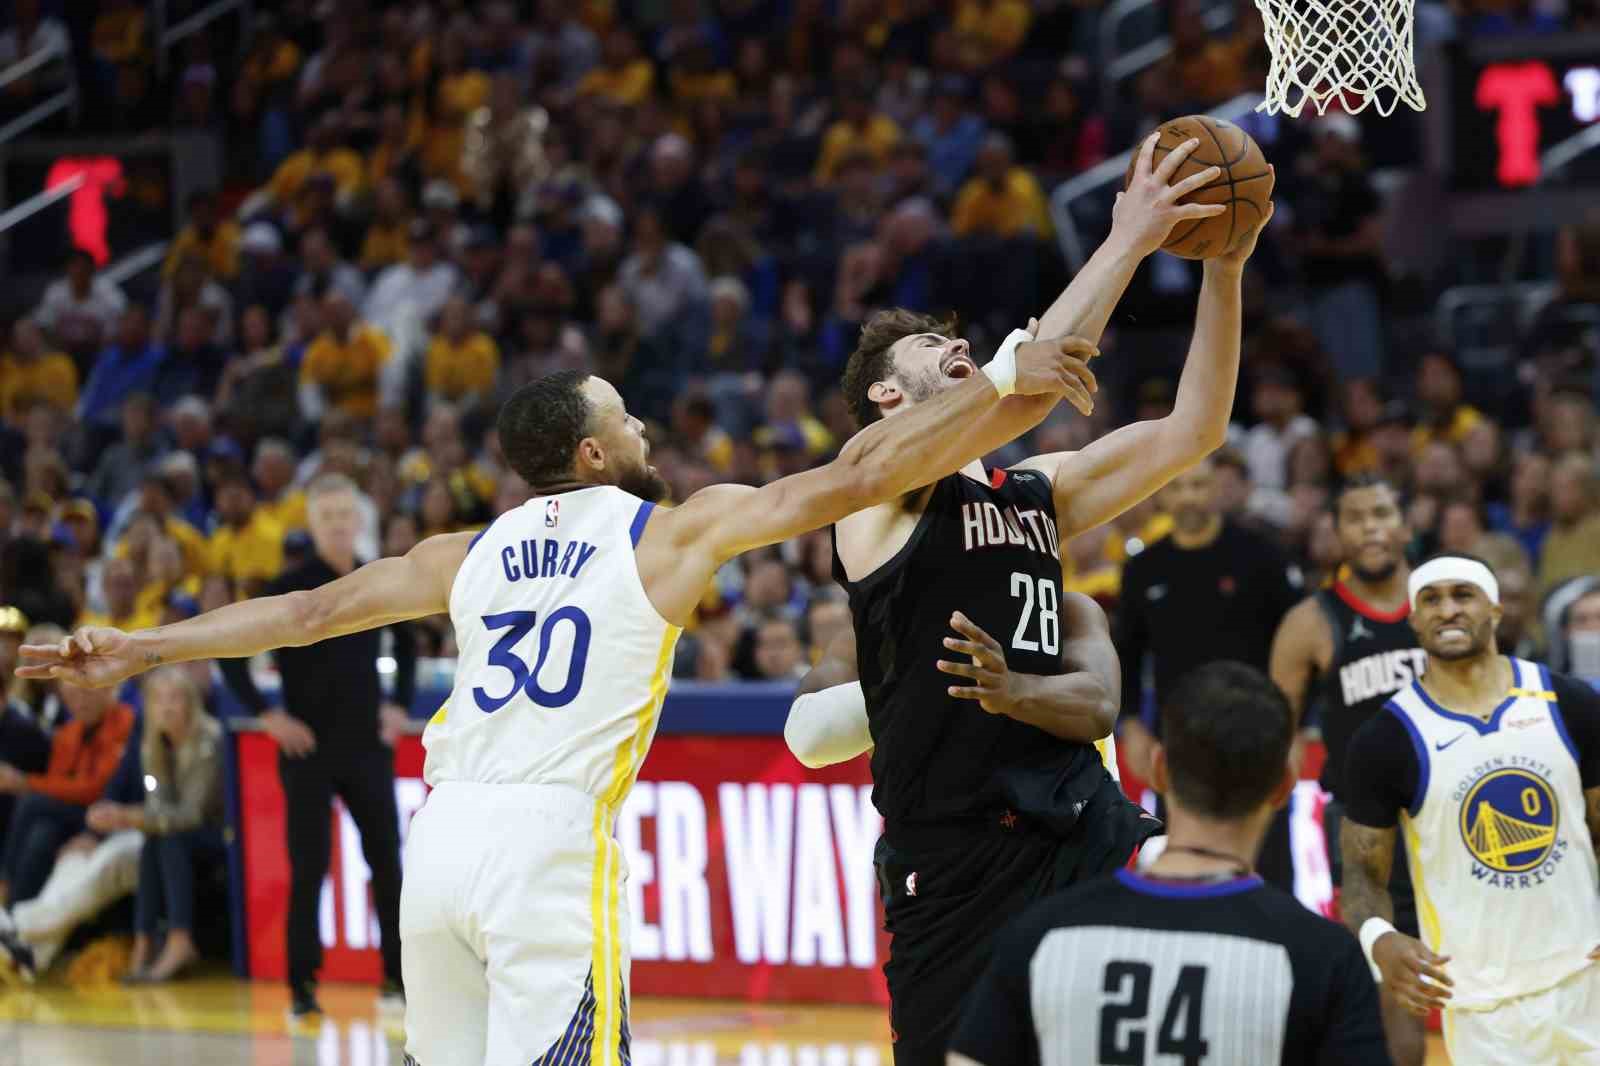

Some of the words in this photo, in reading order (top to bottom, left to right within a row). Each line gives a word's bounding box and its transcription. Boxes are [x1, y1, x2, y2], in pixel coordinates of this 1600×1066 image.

[501, 538, 597, 582] CURRY
[1010, 572, 1059, 656] 28
[472, 605, 592, 714] 30
[1340, 648, 1428, 706] HOUST
[1453, 757, 1503, 801] GOLDEN
[1511, 756, 1552, 777] STATE
[1520, 787, 1541, 816] 0
[718, 783, 884, 969] WAY
[1471, 840, 1568, 889] WARRIORS
[1098, 960, 1208, 1066] 24
